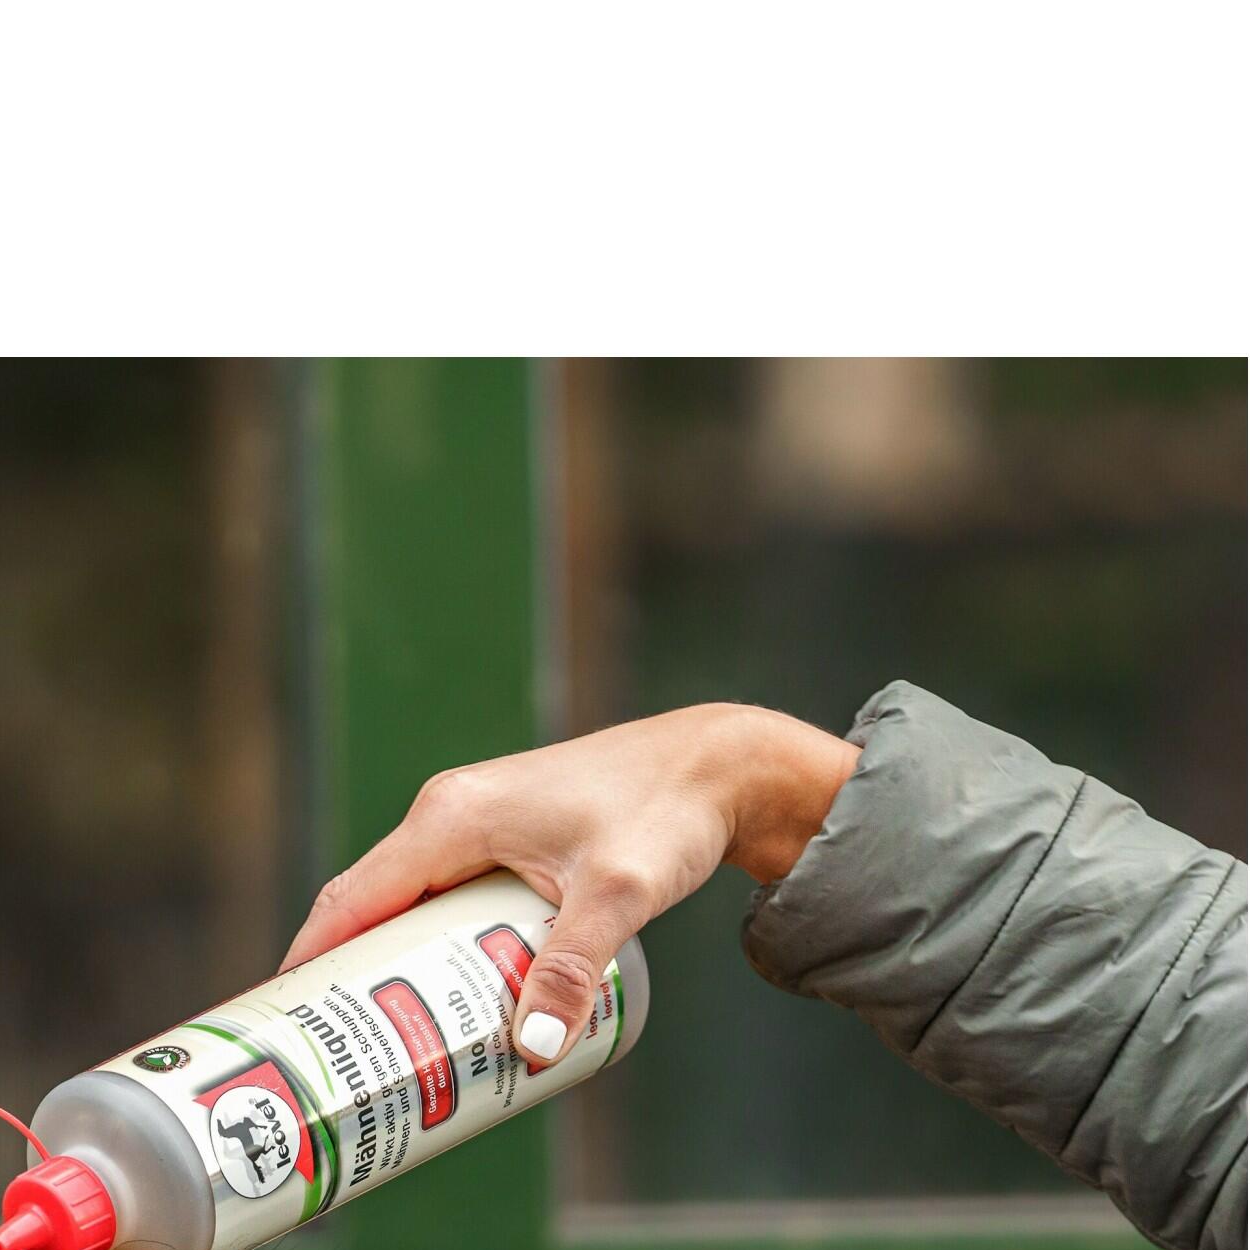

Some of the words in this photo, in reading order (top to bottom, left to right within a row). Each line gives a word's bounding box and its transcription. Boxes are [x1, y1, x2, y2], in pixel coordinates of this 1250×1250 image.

[323, 996, 372, 1054] Schuppen,
[330, 983, 404, 1085] Schweifscheuern.
[447, 989, 479, 1038] Rub
[495, 1003, 511, 1027] and
[470, 1041, 489, 1078] No
[505, 1028, 518, 1063] mane
[369, 1056, 393, 1099] gegen
[434, 1058, 446, 1089] durch
[494, 1050, 506, 1096] Actively
[286, 1004, 377, 1186] Mähnenliquid
[396, 1086, 411, 1113] und
[425, 1074, 437, 1114] Gezielte
[254, 1097, 291, 1169] leovet
[384, 1103, 396, 1136] aktiv
[379, 1136, 396, 1171] Wirkt
[391, 1117, 411, 1170] Mähnen-
